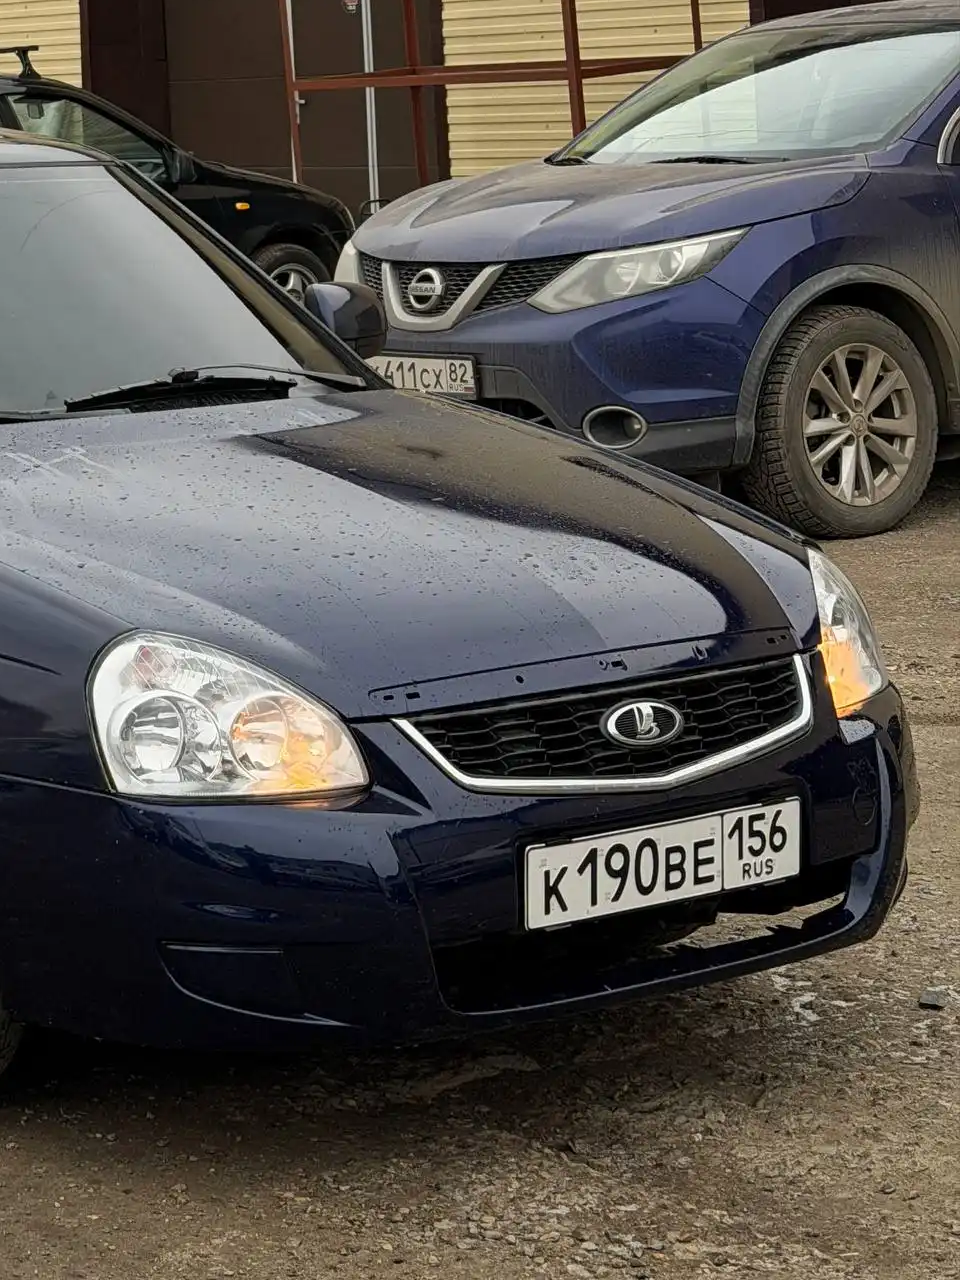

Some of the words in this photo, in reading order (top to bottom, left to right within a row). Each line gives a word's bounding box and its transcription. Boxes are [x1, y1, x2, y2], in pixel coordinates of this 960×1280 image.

[409, 284, 436, 294] NISSAN
[375, 360, 444, 390] 411СХ
[448, 362, 469, 384] 82
[448, 383, 464, 392] RUS
[727, 809, 788, 861] 156
[742, 857, 775, 881] RUS
